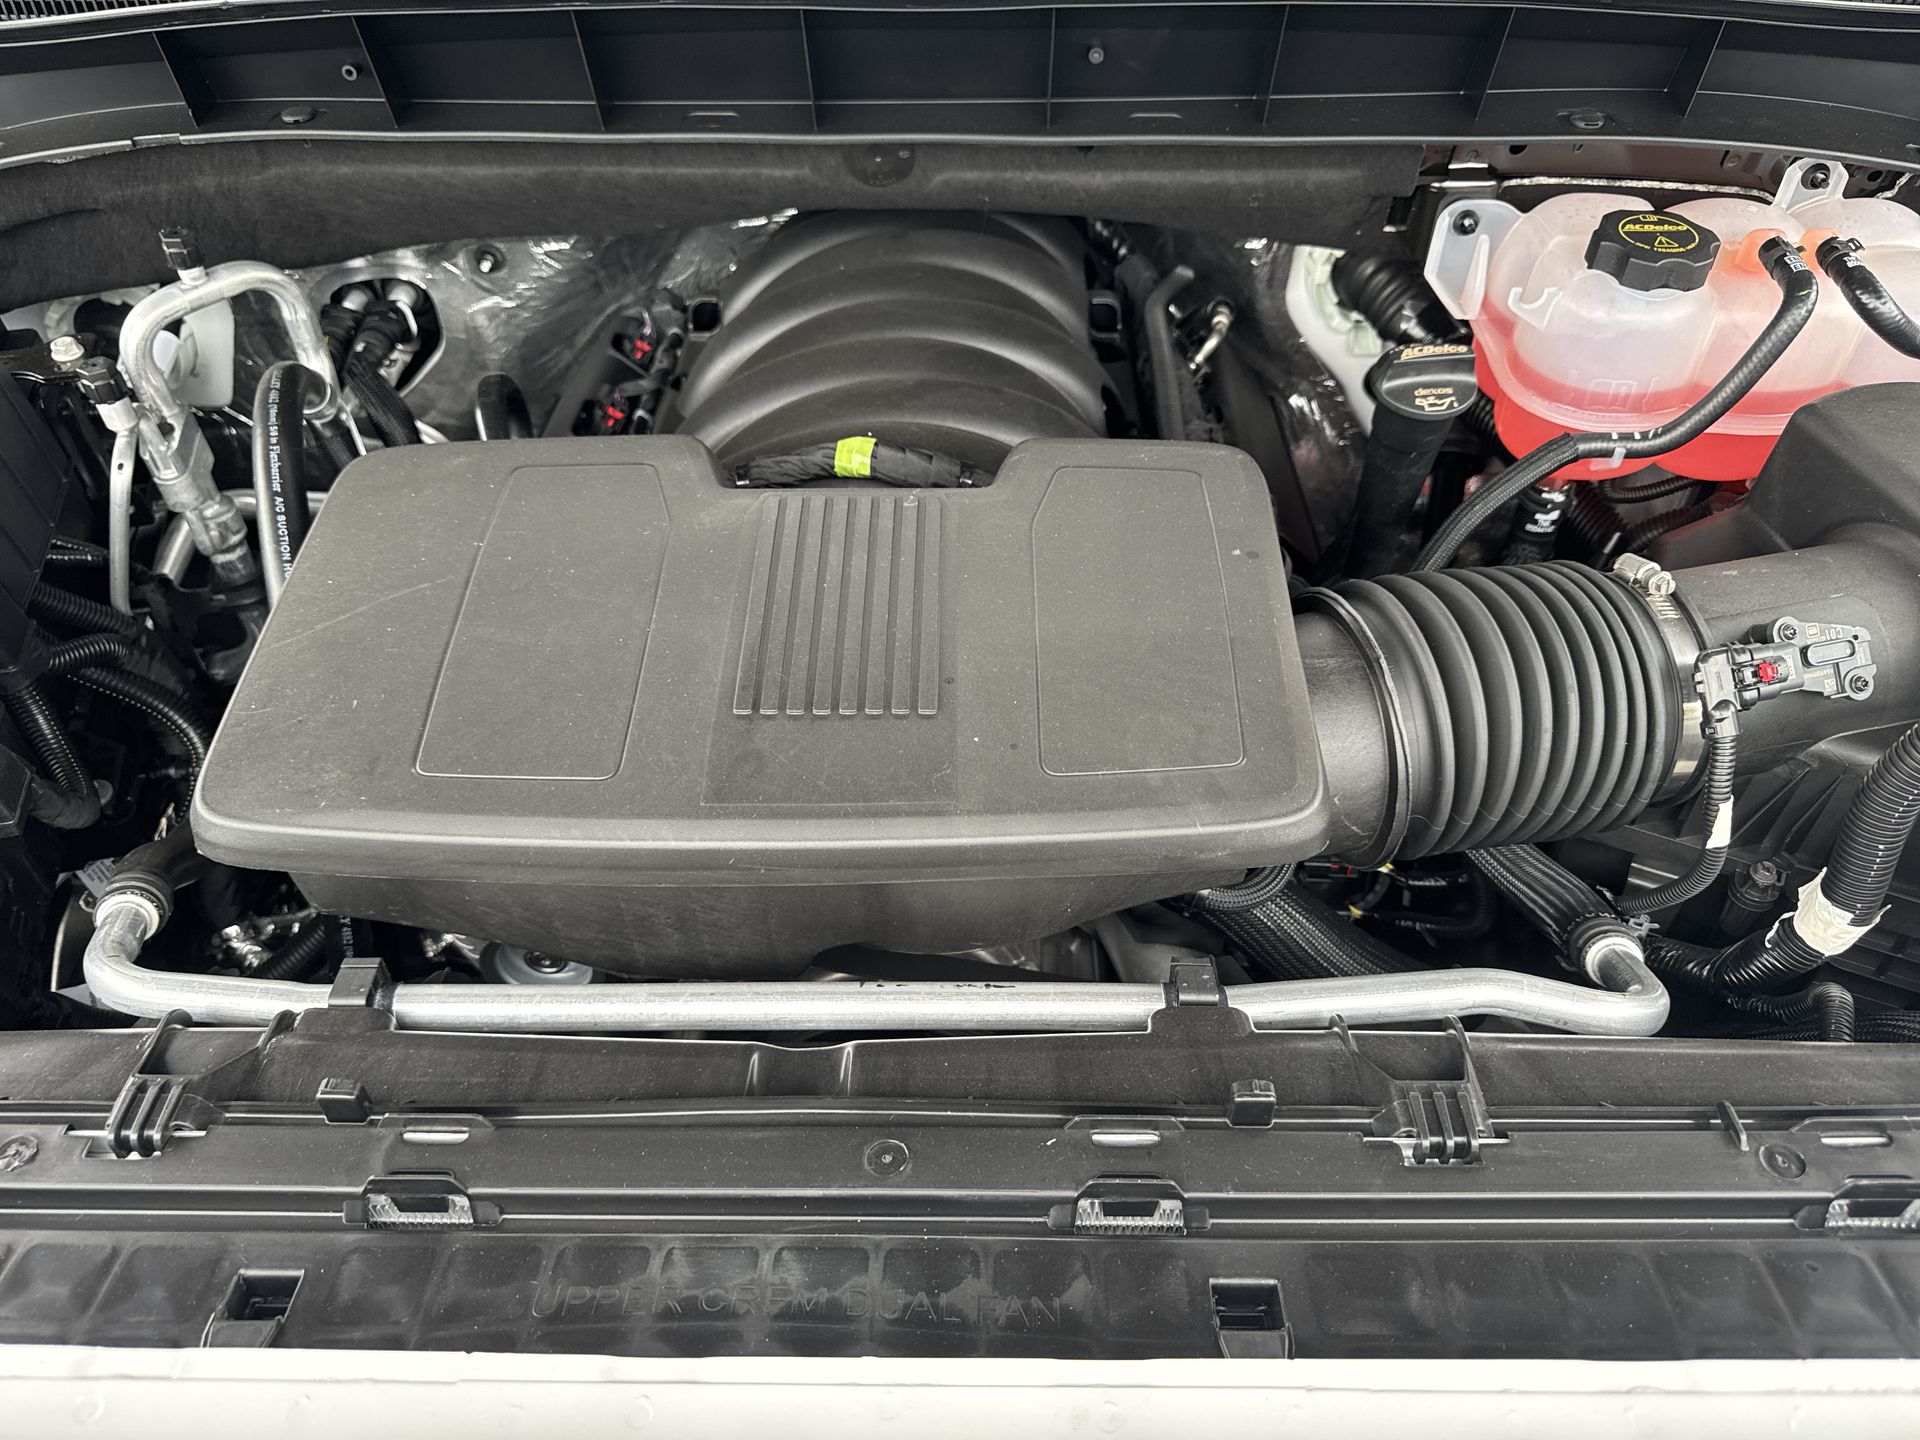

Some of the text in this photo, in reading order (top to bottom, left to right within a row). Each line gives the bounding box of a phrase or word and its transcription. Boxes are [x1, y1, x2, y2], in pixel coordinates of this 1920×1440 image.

[1401, 345, 1468, 360] ACDelco
[1414, 388, 1453, 396] dexos
[269, 446, 283, 492] Flexbarrier
[274, 496, 285, 513] A/C
[277, 515, 291, 560] SUCTION
[531, 1284, 683, 1318] UPPER
[843, 1288, 961, 1321] DUAL
[975, 1294, 1061, 1329] FAN
